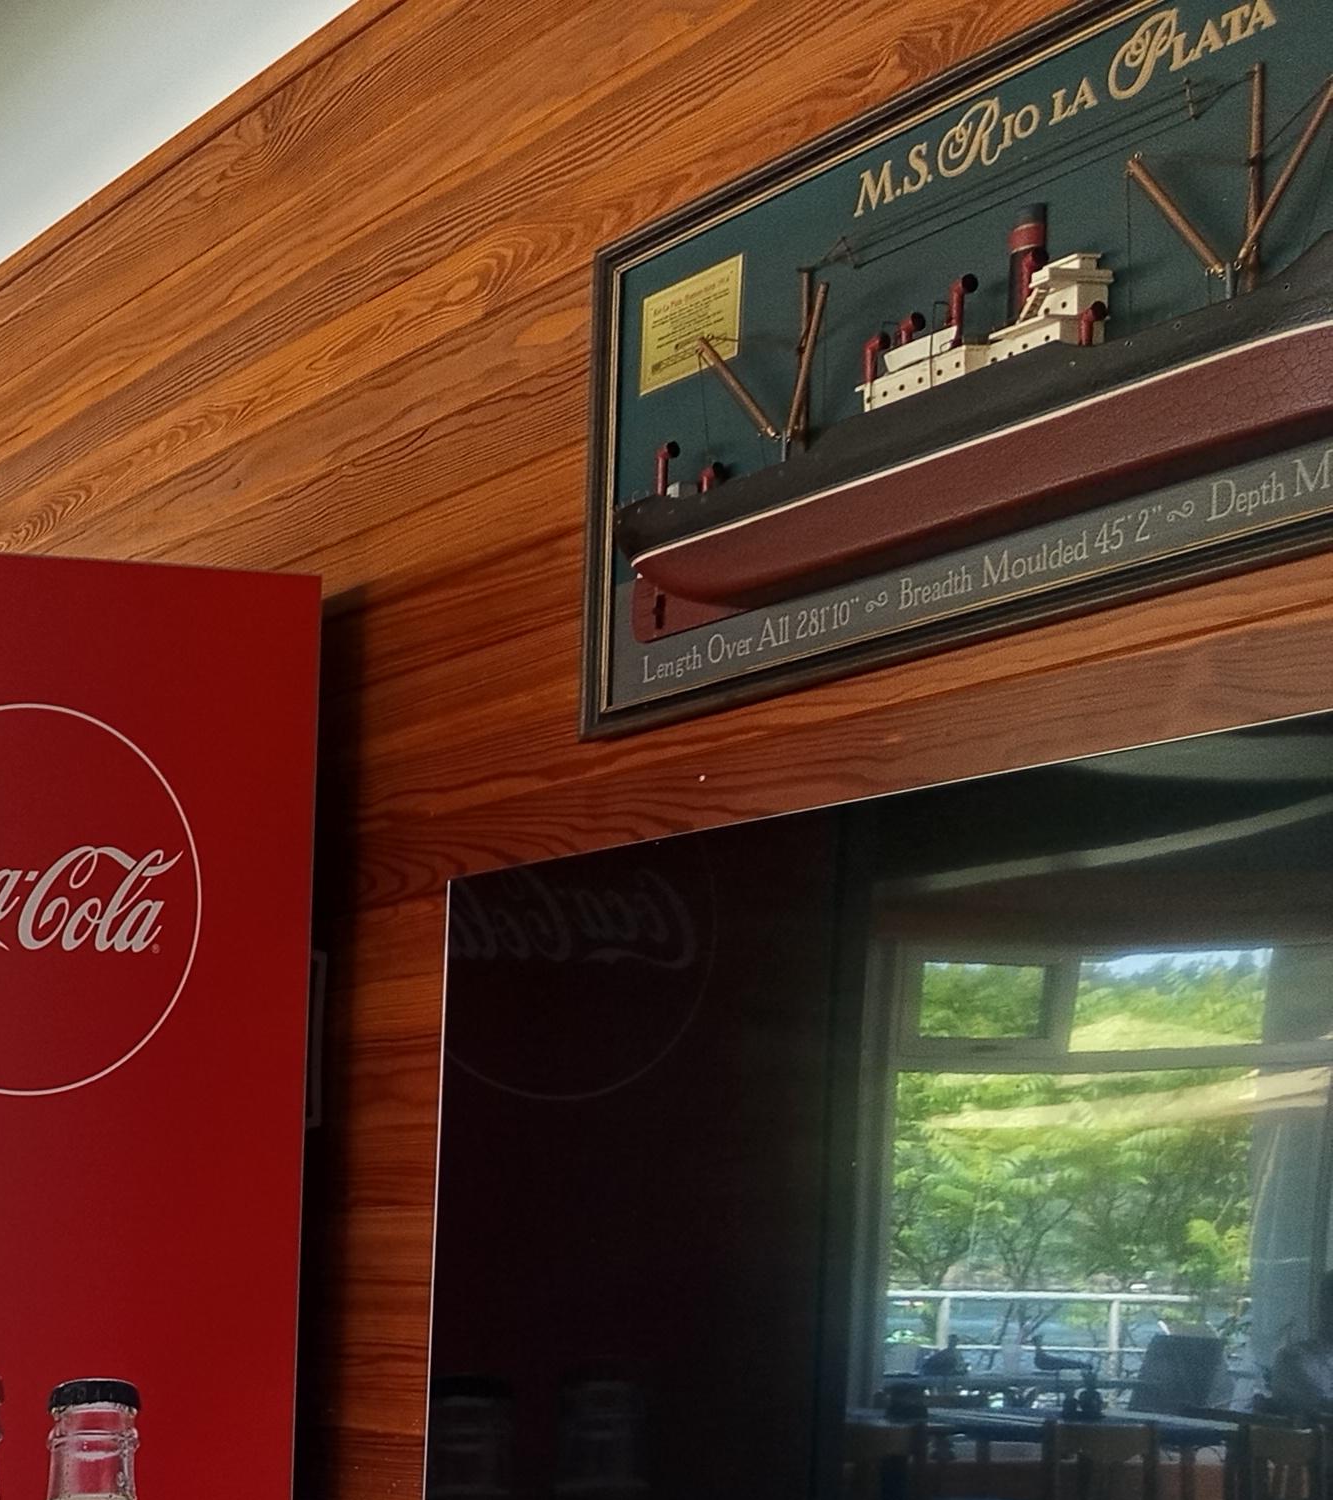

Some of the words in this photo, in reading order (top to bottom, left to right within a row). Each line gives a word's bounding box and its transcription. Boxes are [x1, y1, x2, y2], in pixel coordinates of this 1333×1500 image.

[854, 143, 932, 218] M.S.
[1049, 76, 1098, 126] LA
[1108, 0, 1278, 100] PLATA
[643, 645, 702, 684] Length
[707, 633, 753, 664] Over
[757, 614, 789, 651] All
[899, 566, 973, 610] Breadth
[981, 532, 1089, 588] Moulded
[1207, 471, 1285, 522] Depth
